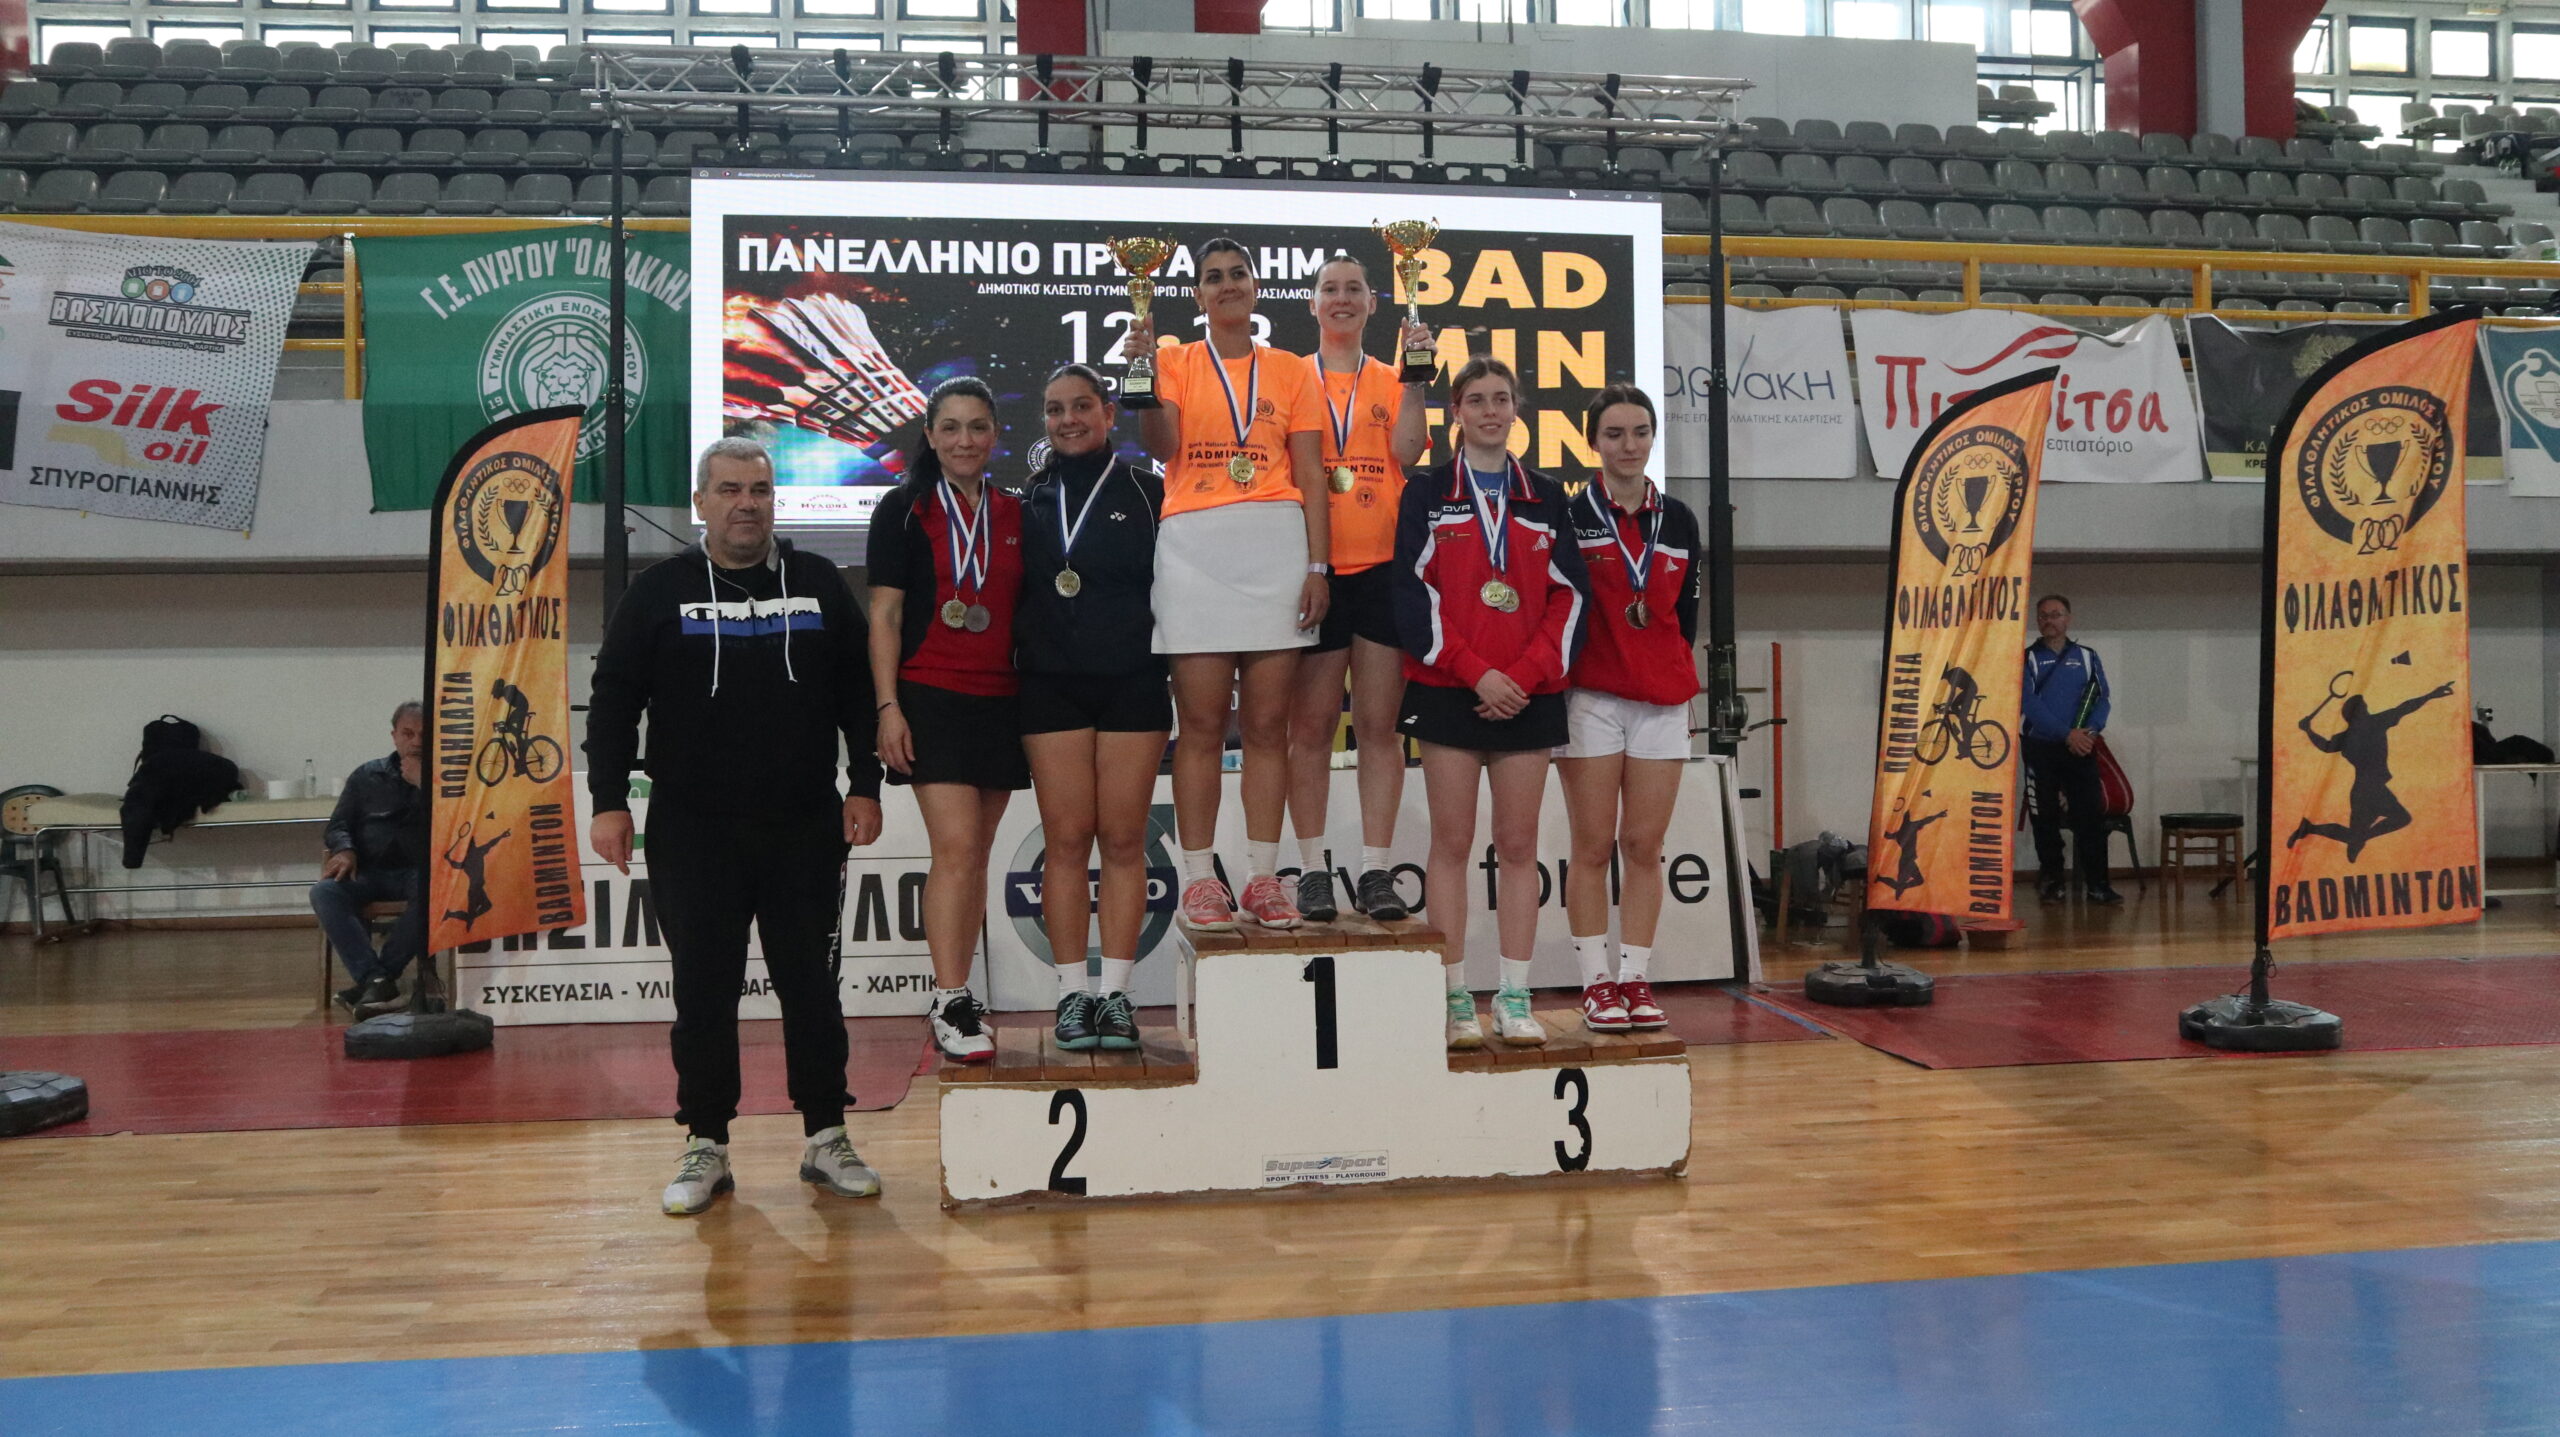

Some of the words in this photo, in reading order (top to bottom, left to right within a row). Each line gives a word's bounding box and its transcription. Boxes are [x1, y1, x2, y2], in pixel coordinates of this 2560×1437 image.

[739, 238, 1040, 276] ΠΑΝΕΛΛΗΝΙΟ
[1393, 247, 1608, 310] BAD
[51, 297, 250, 339] ΒΑΣΙΛΟΠΟΥΛΟΣ
[977, 282, 1040, 296] ΔΗΜΟΤΙΚΟ
[1043, 283, 1092, 296] ΚΛΕΙΣΤΟ
[488, 302, 555, 381] ΓΥΜΝΑΣΤΙΚΗ
[55, 379, 226, 438] Silk
[1784, 415, 1842, 425] ΚΑΤΑΡΤΙΣΗΣ
[143, 438, 209, 466] oil
[1976, 430, 2019, 456] ΟΜΙΛΟΣ
[2046, 435, 2134, 457] εστιατόριο
[2304, 396, 2371, 508] ΦΙΛΑΘΛΗΤΙΚΟΣ
[29, 466, 222, 505] ΣΠΥΡΟΓΙΑΝΝΗΣ
[440, 671, 475, 799] ΠΟΔΗΛΑΣΙΑ
[1884, 652, 1922, 773] ΠΟΔΗΛΑΣΙΑ
[530, 803, 575, 925] BADMINTON
[1969, 791, 2004, 914] BADMINTON
[2274, 865, 2480, 928] BADMINTON
[482, 982, 614, 1005] ΣΥΣΚΕΥΑΣΙΑ
[1302, 956, 1338, 1070] 1
[1048, 1088, 1088, 1196] 2
[1554, 1067, 1593, 1173] 3
[1335, 1171, 1386, 1179] PLAYGROUND
